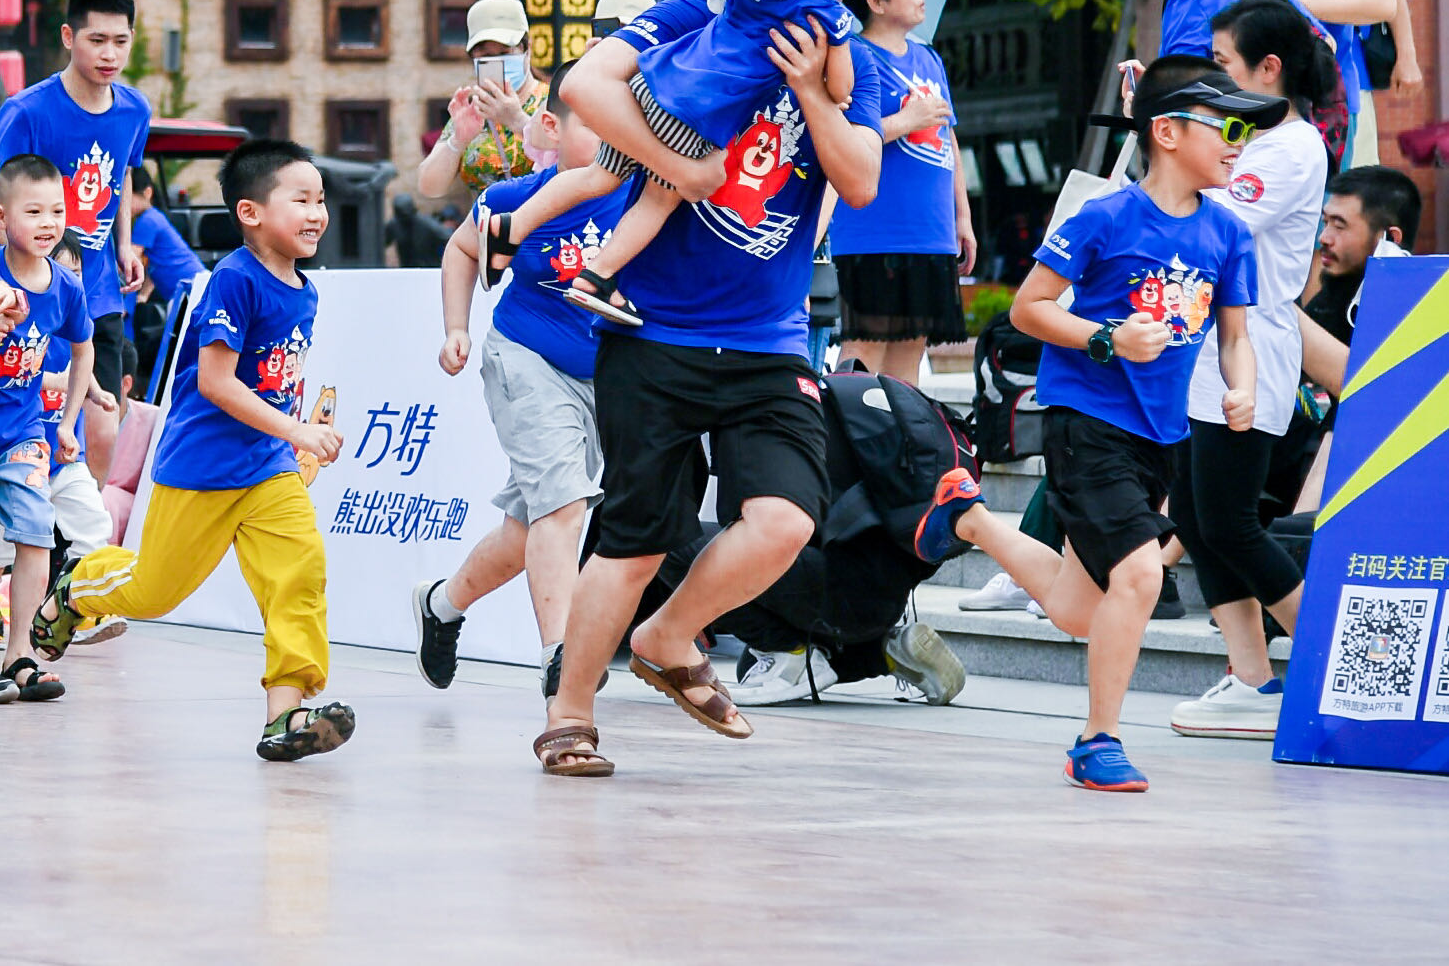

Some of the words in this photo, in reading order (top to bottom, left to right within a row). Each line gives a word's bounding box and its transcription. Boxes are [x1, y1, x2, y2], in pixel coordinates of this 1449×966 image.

[354, 402, 439, 476] 方特
[330, 488, 469, 543] 熊出没欢乐跑
[1347, 553, 1449, 581] 扫码关注官
